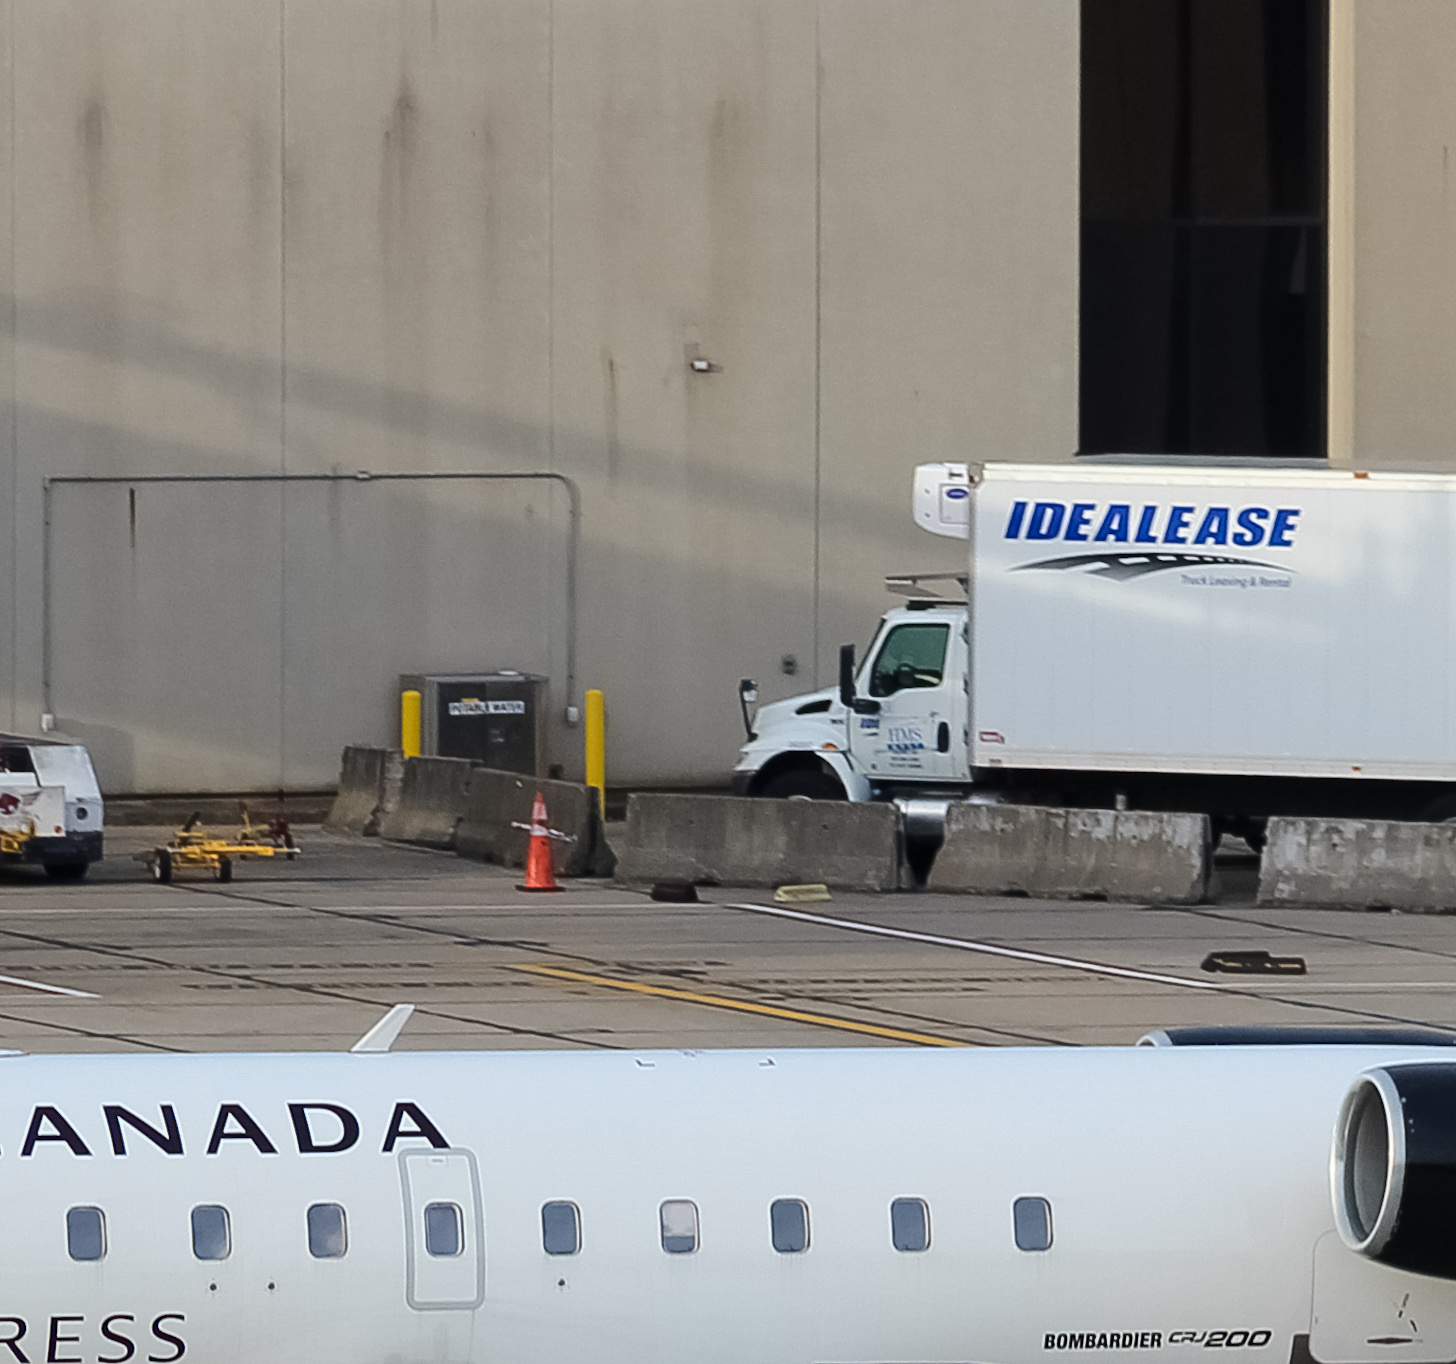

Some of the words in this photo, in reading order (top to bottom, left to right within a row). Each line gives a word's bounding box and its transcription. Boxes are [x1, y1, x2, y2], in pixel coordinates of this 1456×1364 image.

[1004, 501, 1301, 547] IDEALEASE
[888, 728, 922, 742] HMS
[1043, 1332, 1162, 1350] BOMBARDIER
